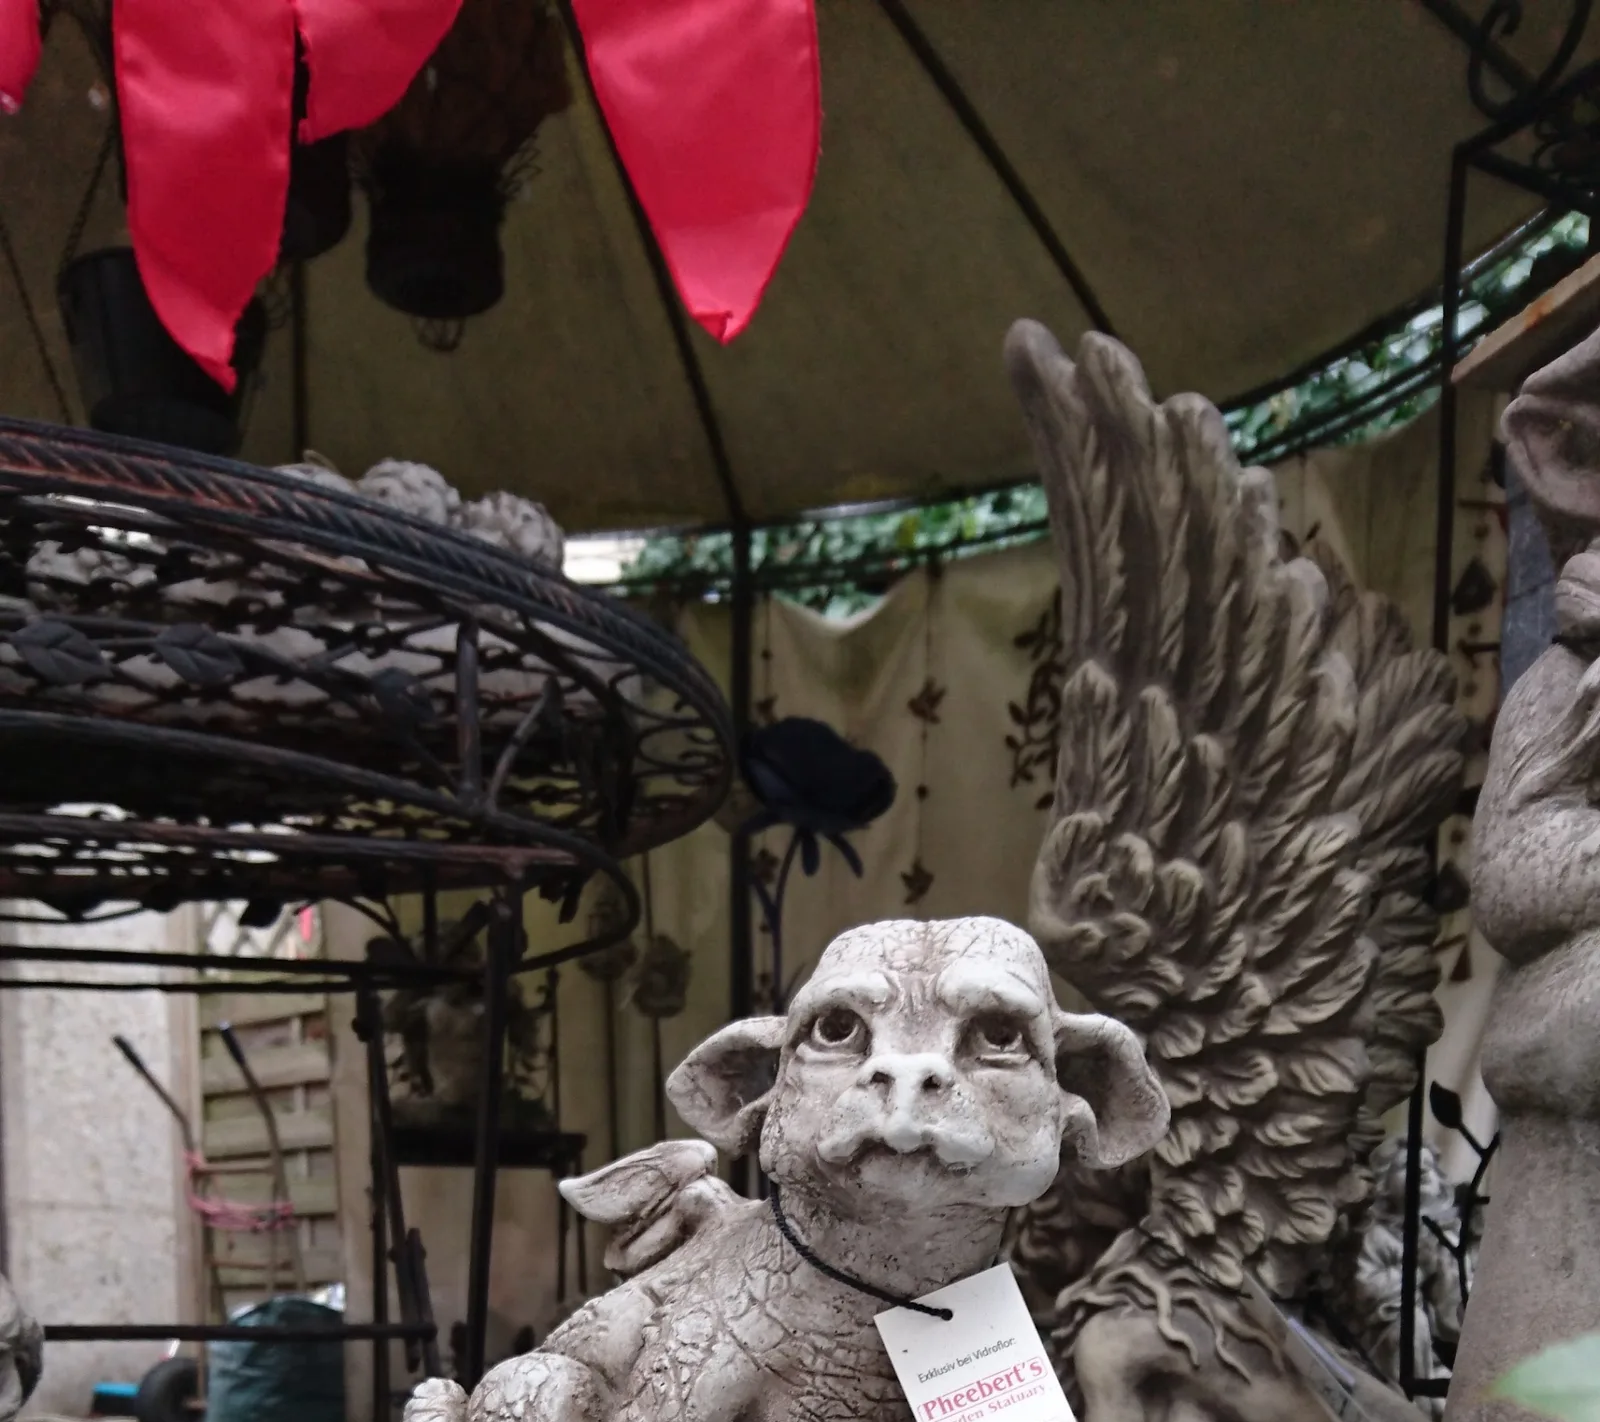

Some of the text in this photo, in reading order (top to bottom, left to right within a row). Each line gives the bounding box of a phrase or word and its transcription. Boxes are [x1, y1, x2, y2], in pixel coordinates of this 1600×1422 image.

[918, 1337, 1017, 1384] Exklusiv bei Vidroflor:
[922, 1359, 1043, 1421] Pheebert's
[987, 1384, 1046, 1413] Statuary
